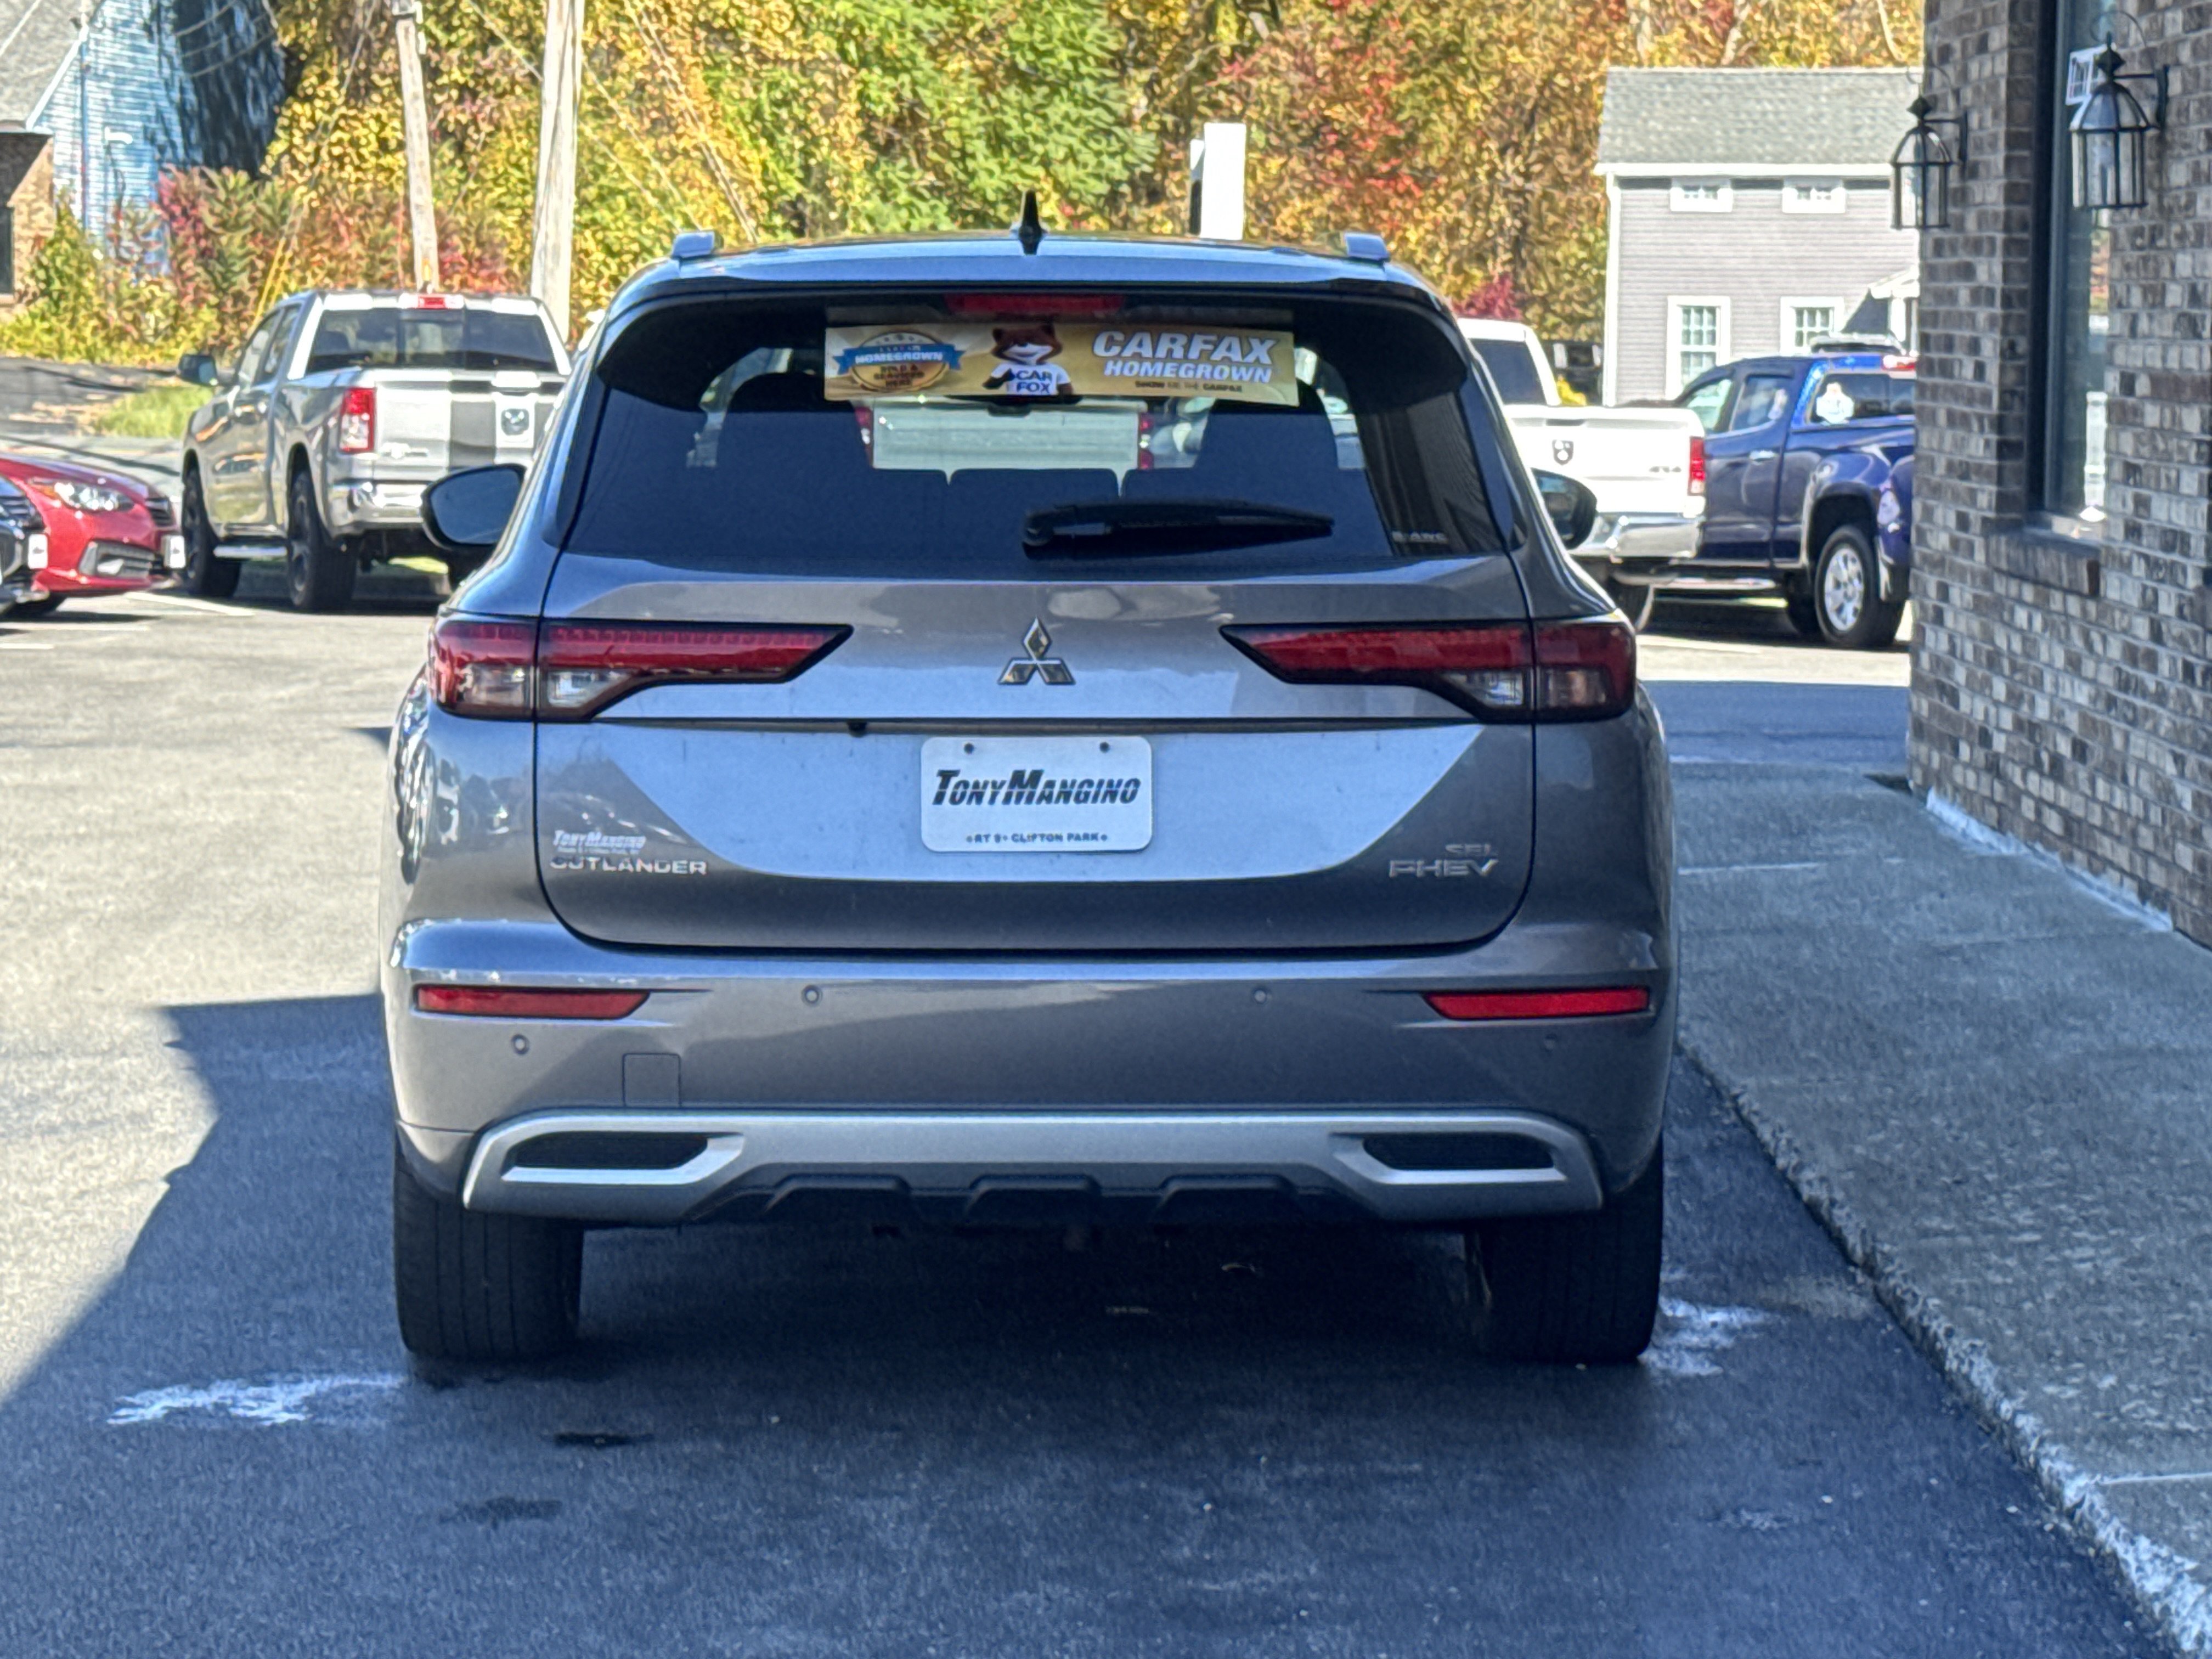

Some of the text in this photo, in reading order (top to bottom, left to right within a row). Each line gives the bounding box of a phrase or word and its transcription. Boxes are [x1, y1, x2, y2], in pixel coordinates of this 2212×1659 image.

[1093, 330, 1277, 365] CARFAX
[1017, 370, 1052, 381] CAR
[1104, 360, 1272, 383] HOMEGROWN
[1017, 382, 1050, 393] FOX
[1067, 832, 1099, 842] PARK
[550, 856, 708, 875] OUTLANDER
[1389, 859, 1499, 878] PHEV
